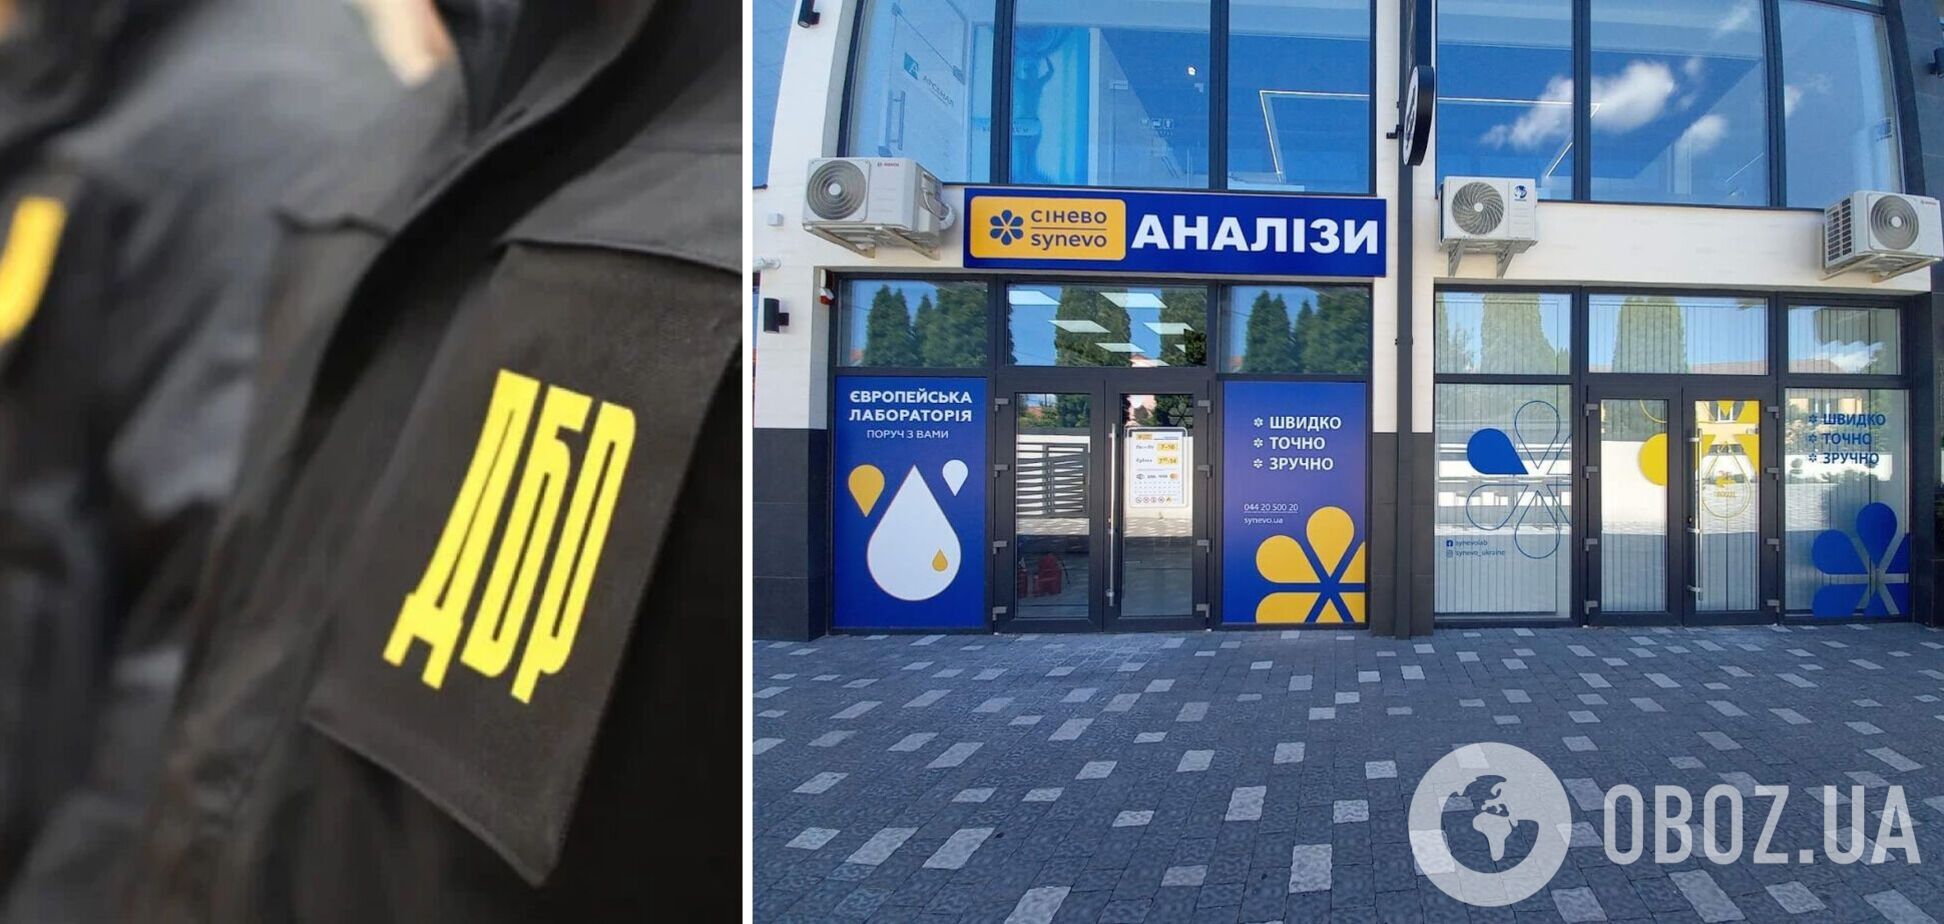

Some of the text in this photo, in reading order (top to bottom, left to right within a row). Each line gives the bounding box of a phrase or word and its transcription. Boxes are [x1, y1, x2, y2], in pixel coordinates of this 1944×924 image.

[1031, 232, 1107, 251] synevo
[1131, 214, 1378, 255] АНАЛІЗИ
[849, 387, 973, 404] ЄВРОПЕЙСЬКА
[849, 408, 972, 422] ЛАБОРАТОРІЯ
[1823, 413, 1886, 428] ШВИДКО
[1269, 416, 1342, 432] ШВИДКО
[866, 429, 949, 439] ПОРУЧ З ВАМИ
[1822, 432, 1872, 445] ТОЧНО
[1269, 436, 1326, 450] ТОЧНО
[1269, 457, 1334, 471] ЗРУЧНО
[1823, 452, 1880, 465] ЗРУЧНО
[1243, 503, 1299, 511] 044 20 500 20
[1243, 516, 1283, 526] synevo.ua
[383, 369, 636, 703] ДБР
